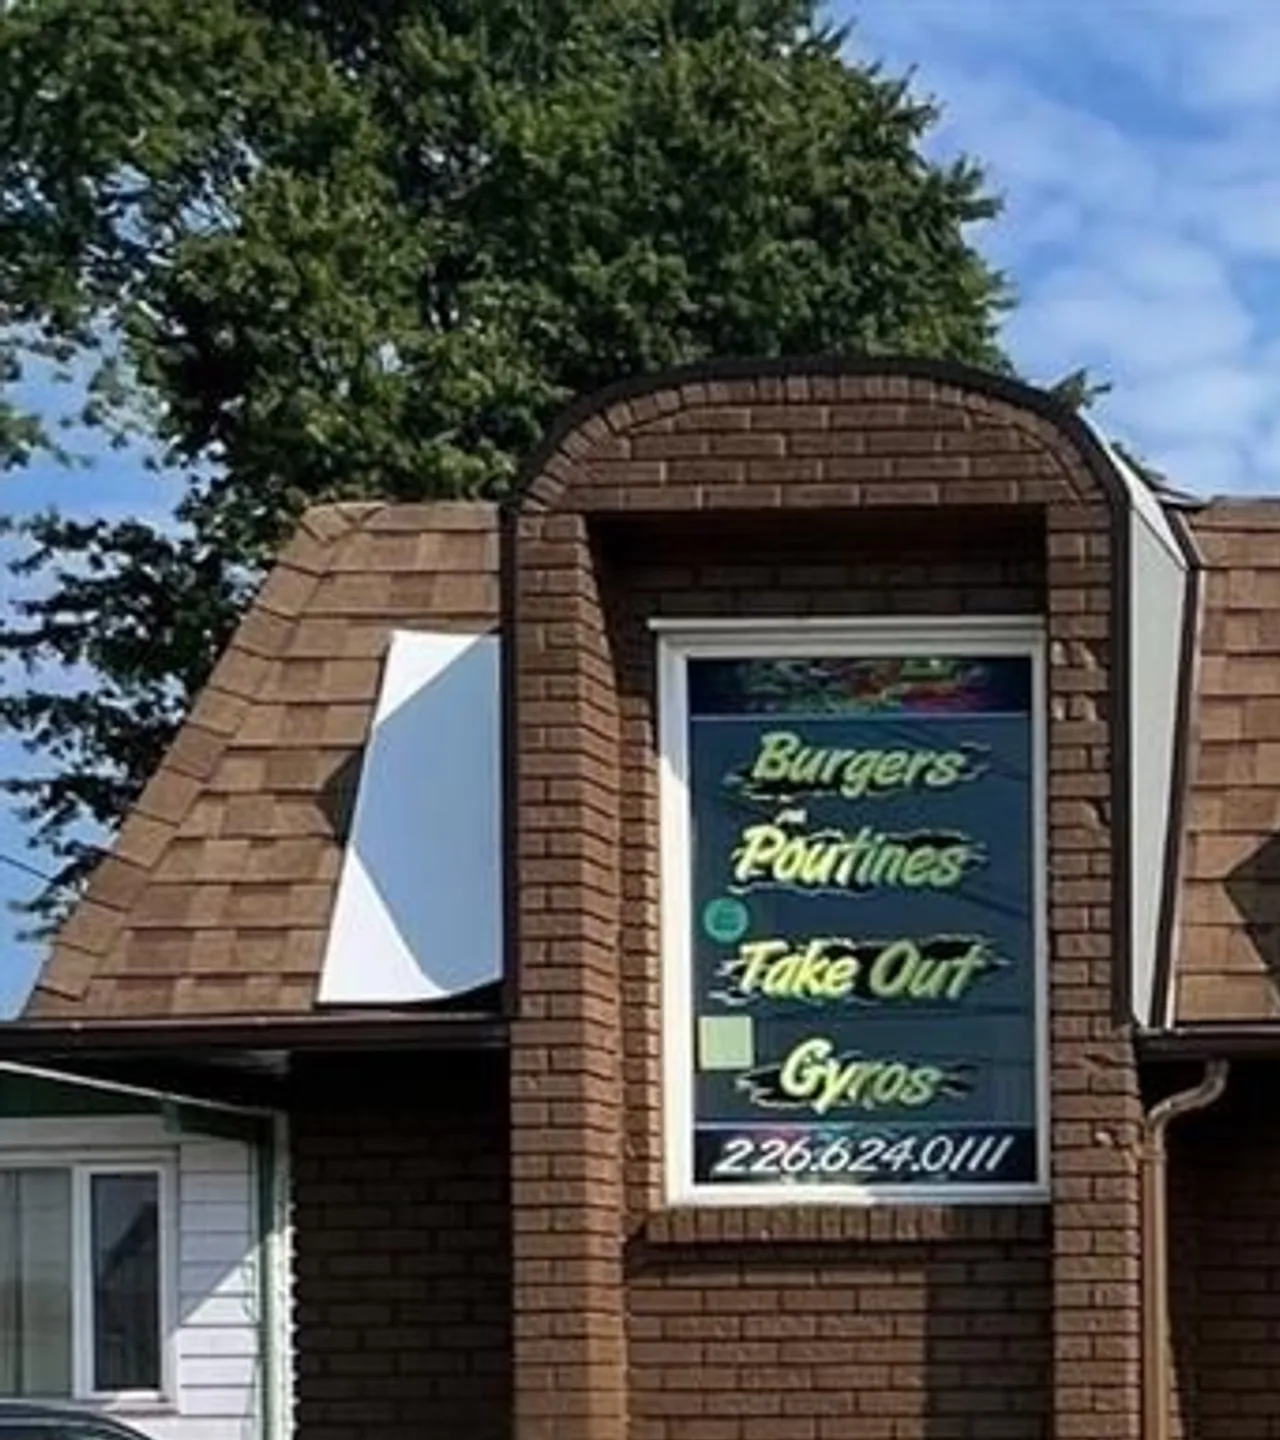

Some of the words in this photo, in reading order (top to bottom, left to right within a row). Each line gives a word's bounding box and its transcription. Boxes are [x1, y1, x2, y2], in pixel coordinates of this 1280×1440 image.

[751, 731, 966, 797] Burgers
[733, 824, 968, 887] Poutines
[738, 940, 857, 998] Take
[868, 938, 984, 1000] Out
[778, 1038, 942, 1112] Gyros
[714, 1136, 1013, 1175] 226.624.0111
